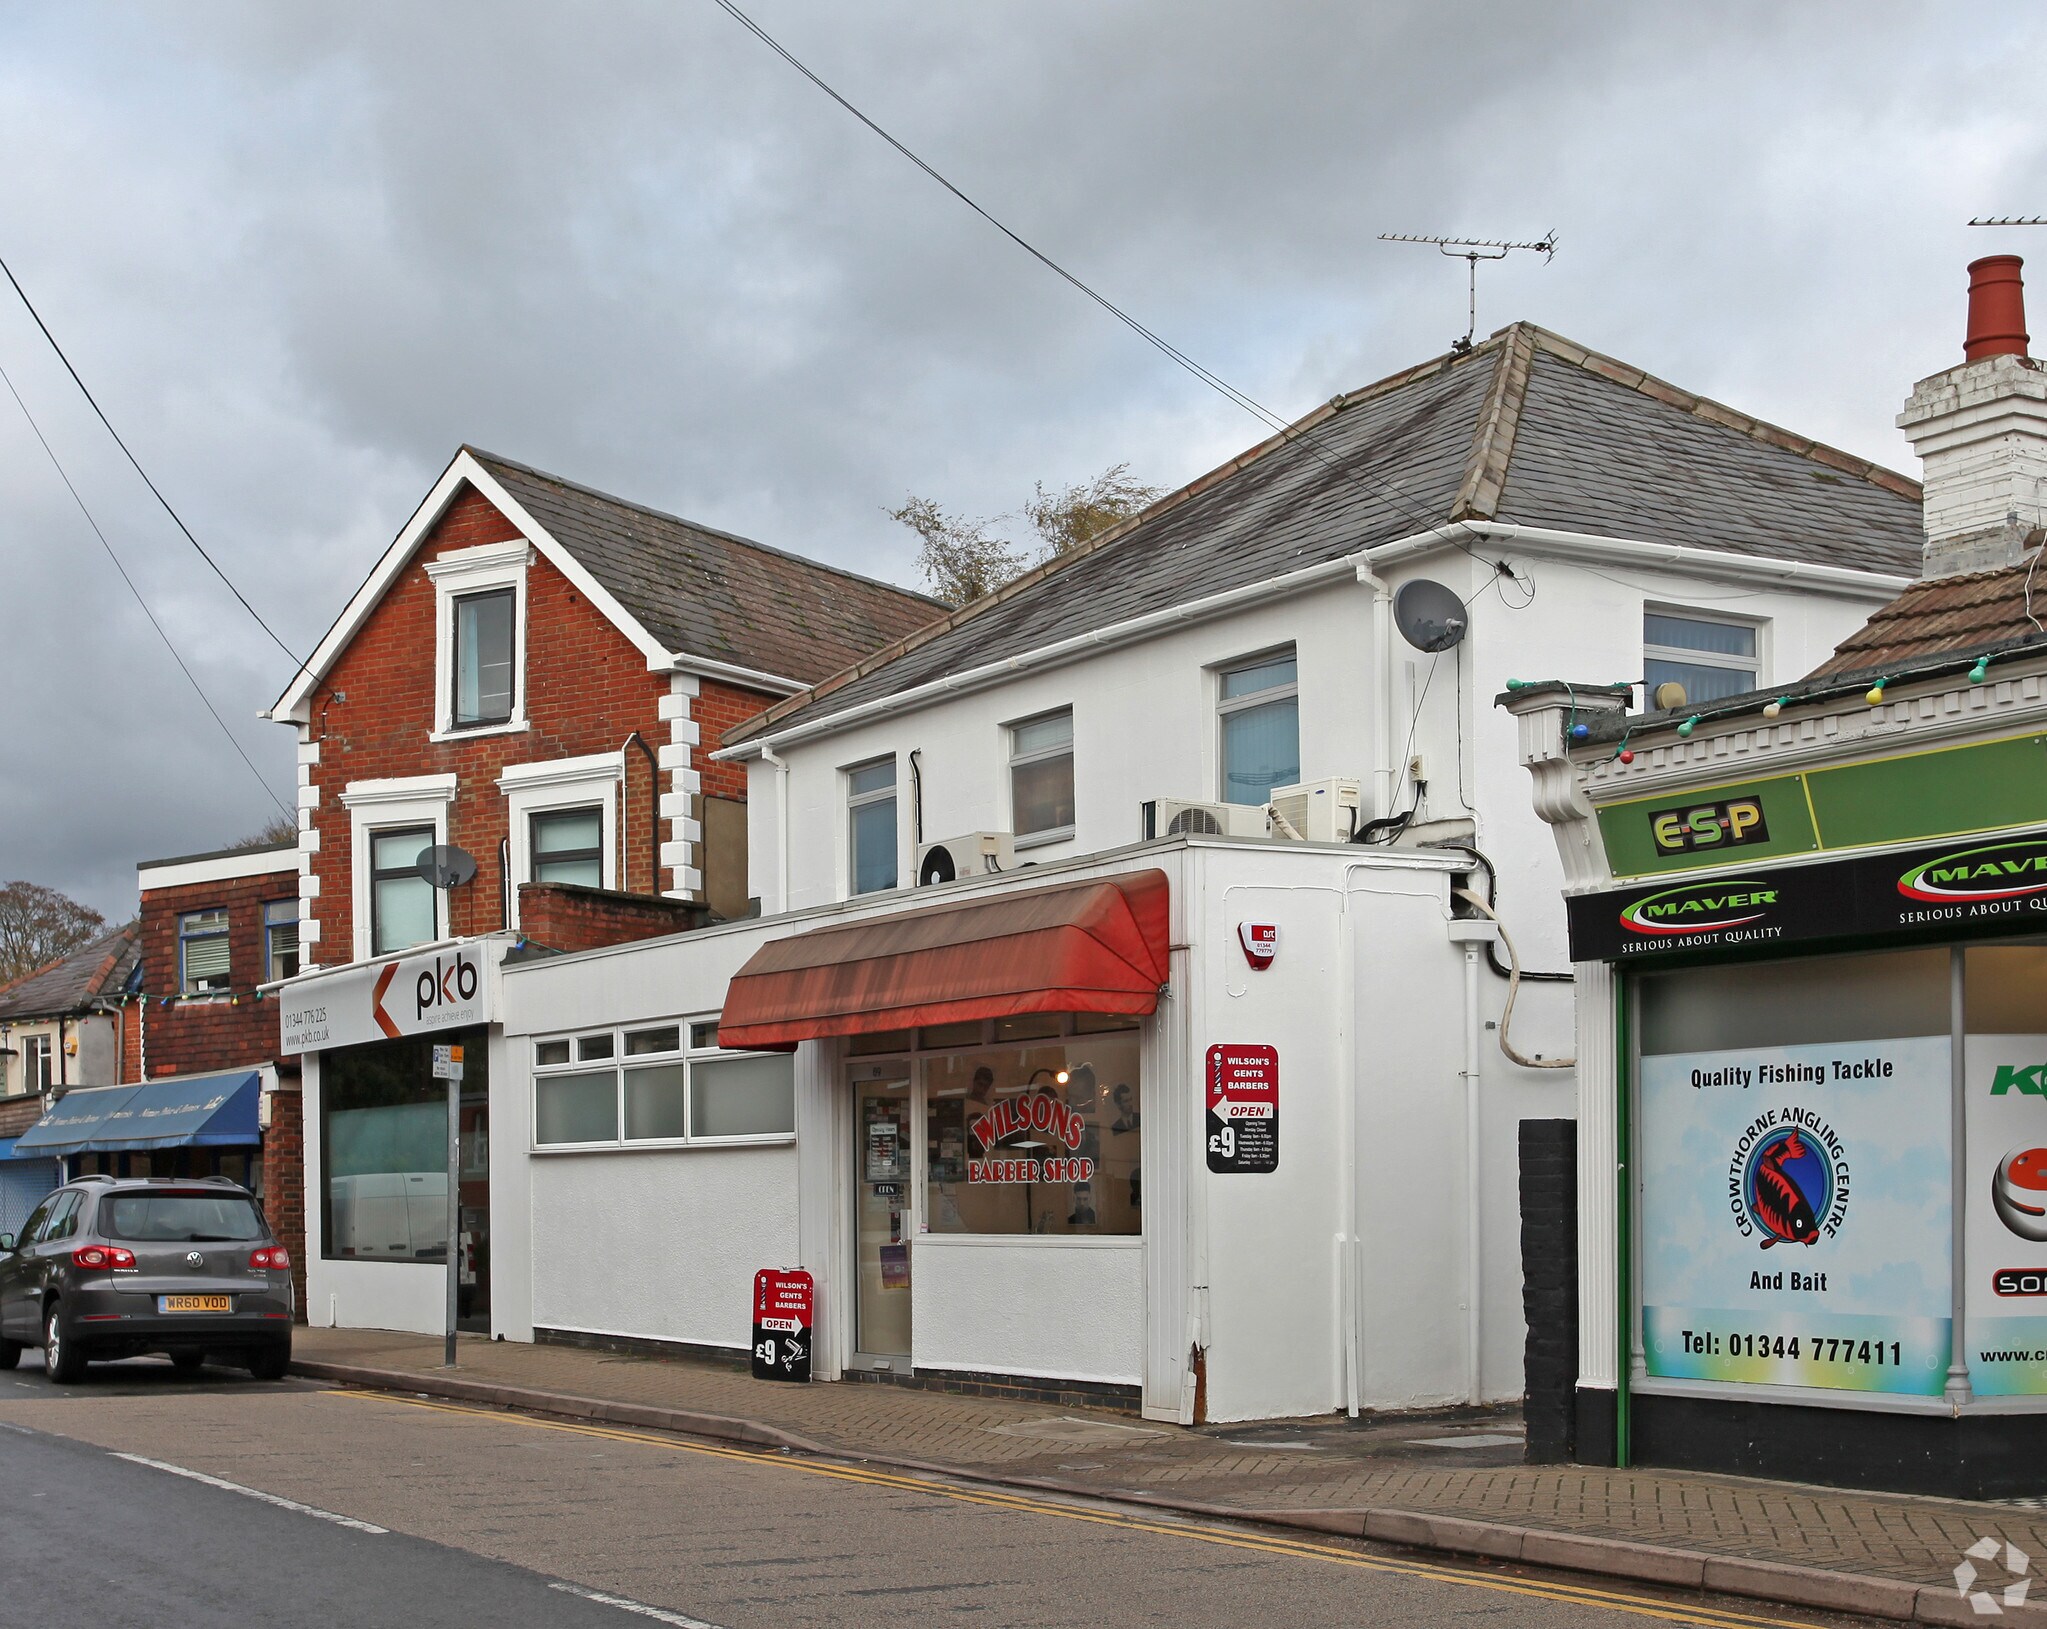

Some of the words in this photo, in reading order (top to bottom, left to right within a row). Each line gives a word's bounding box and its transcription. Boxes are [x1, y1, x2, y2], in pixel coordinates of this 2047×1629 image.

[1647, 891, 1777, 918] MAVER
[1899, 907, 1962, 924] SERIOUS
[1969, 900, 2022, 917] ABOUT
[1622, 938, 1672, 953] SERIOUS
[1677, 933, 1719, 947] ABOUT
[1725, 926, 1782, 943] QUALITY
[416, 952, 478, 1021] pkb
[285, 1009, 303, 1029] 01344
[304, 1009, 315, 1024] 776
[315, 1007, 327, 1022] 225
[426, 1014, 441, 1026] aspire
[441, 1011, 459, 1023] achieve
[459, 1009, 474, 1022] enjoy
[286, 1026, 330, 1049] www.pkb.co.uk
[1691, 1067, 1751, 1089] Quality
[1758, 1063, 1825, 1085] Fishing
[1832, 1058, 1893, 1080] Tackle
[1990, 1062, 2047, 1100] K
[1228, 1082, 1269, 1090] BARBERS
[971, 1093, 1085, 1151] WILSONS
[1230, 1107, 1265, 1116] OPEN
[1208, 1126, 1236, 1158] £9
[968, 1157, 1040, 1184] BARBER
[1043, 1157, 1095, 1183] SHOP
[1728, 1109, 1777, 1237] CROWTHORNE
[1780, 1107, 1844, 1160] ANGLING
[1823, 1161, 1850, 1239] CENTRE
[775, 1282, 807, 1290] WILSON'S
[1750, 1271, 1783, 1290] And
[1790, 1272, 1827, 1292] Bait
[1999, 1276, 2047, 1293] SO
[167, 1298, 200, 1308] WR60
[203, 1298, 227, 1308] VOD
[766, 1320, 792, 1329] OPEN
[755, 1339, 776, 1365] £9
[1682, 1330, 1720, 1355] Tel:
[1729, 1333, 1800, 1359] 01344
[1811, 1338, 1900, 1366] 777411
[1980, 1350, 2047, 1363] www.c
